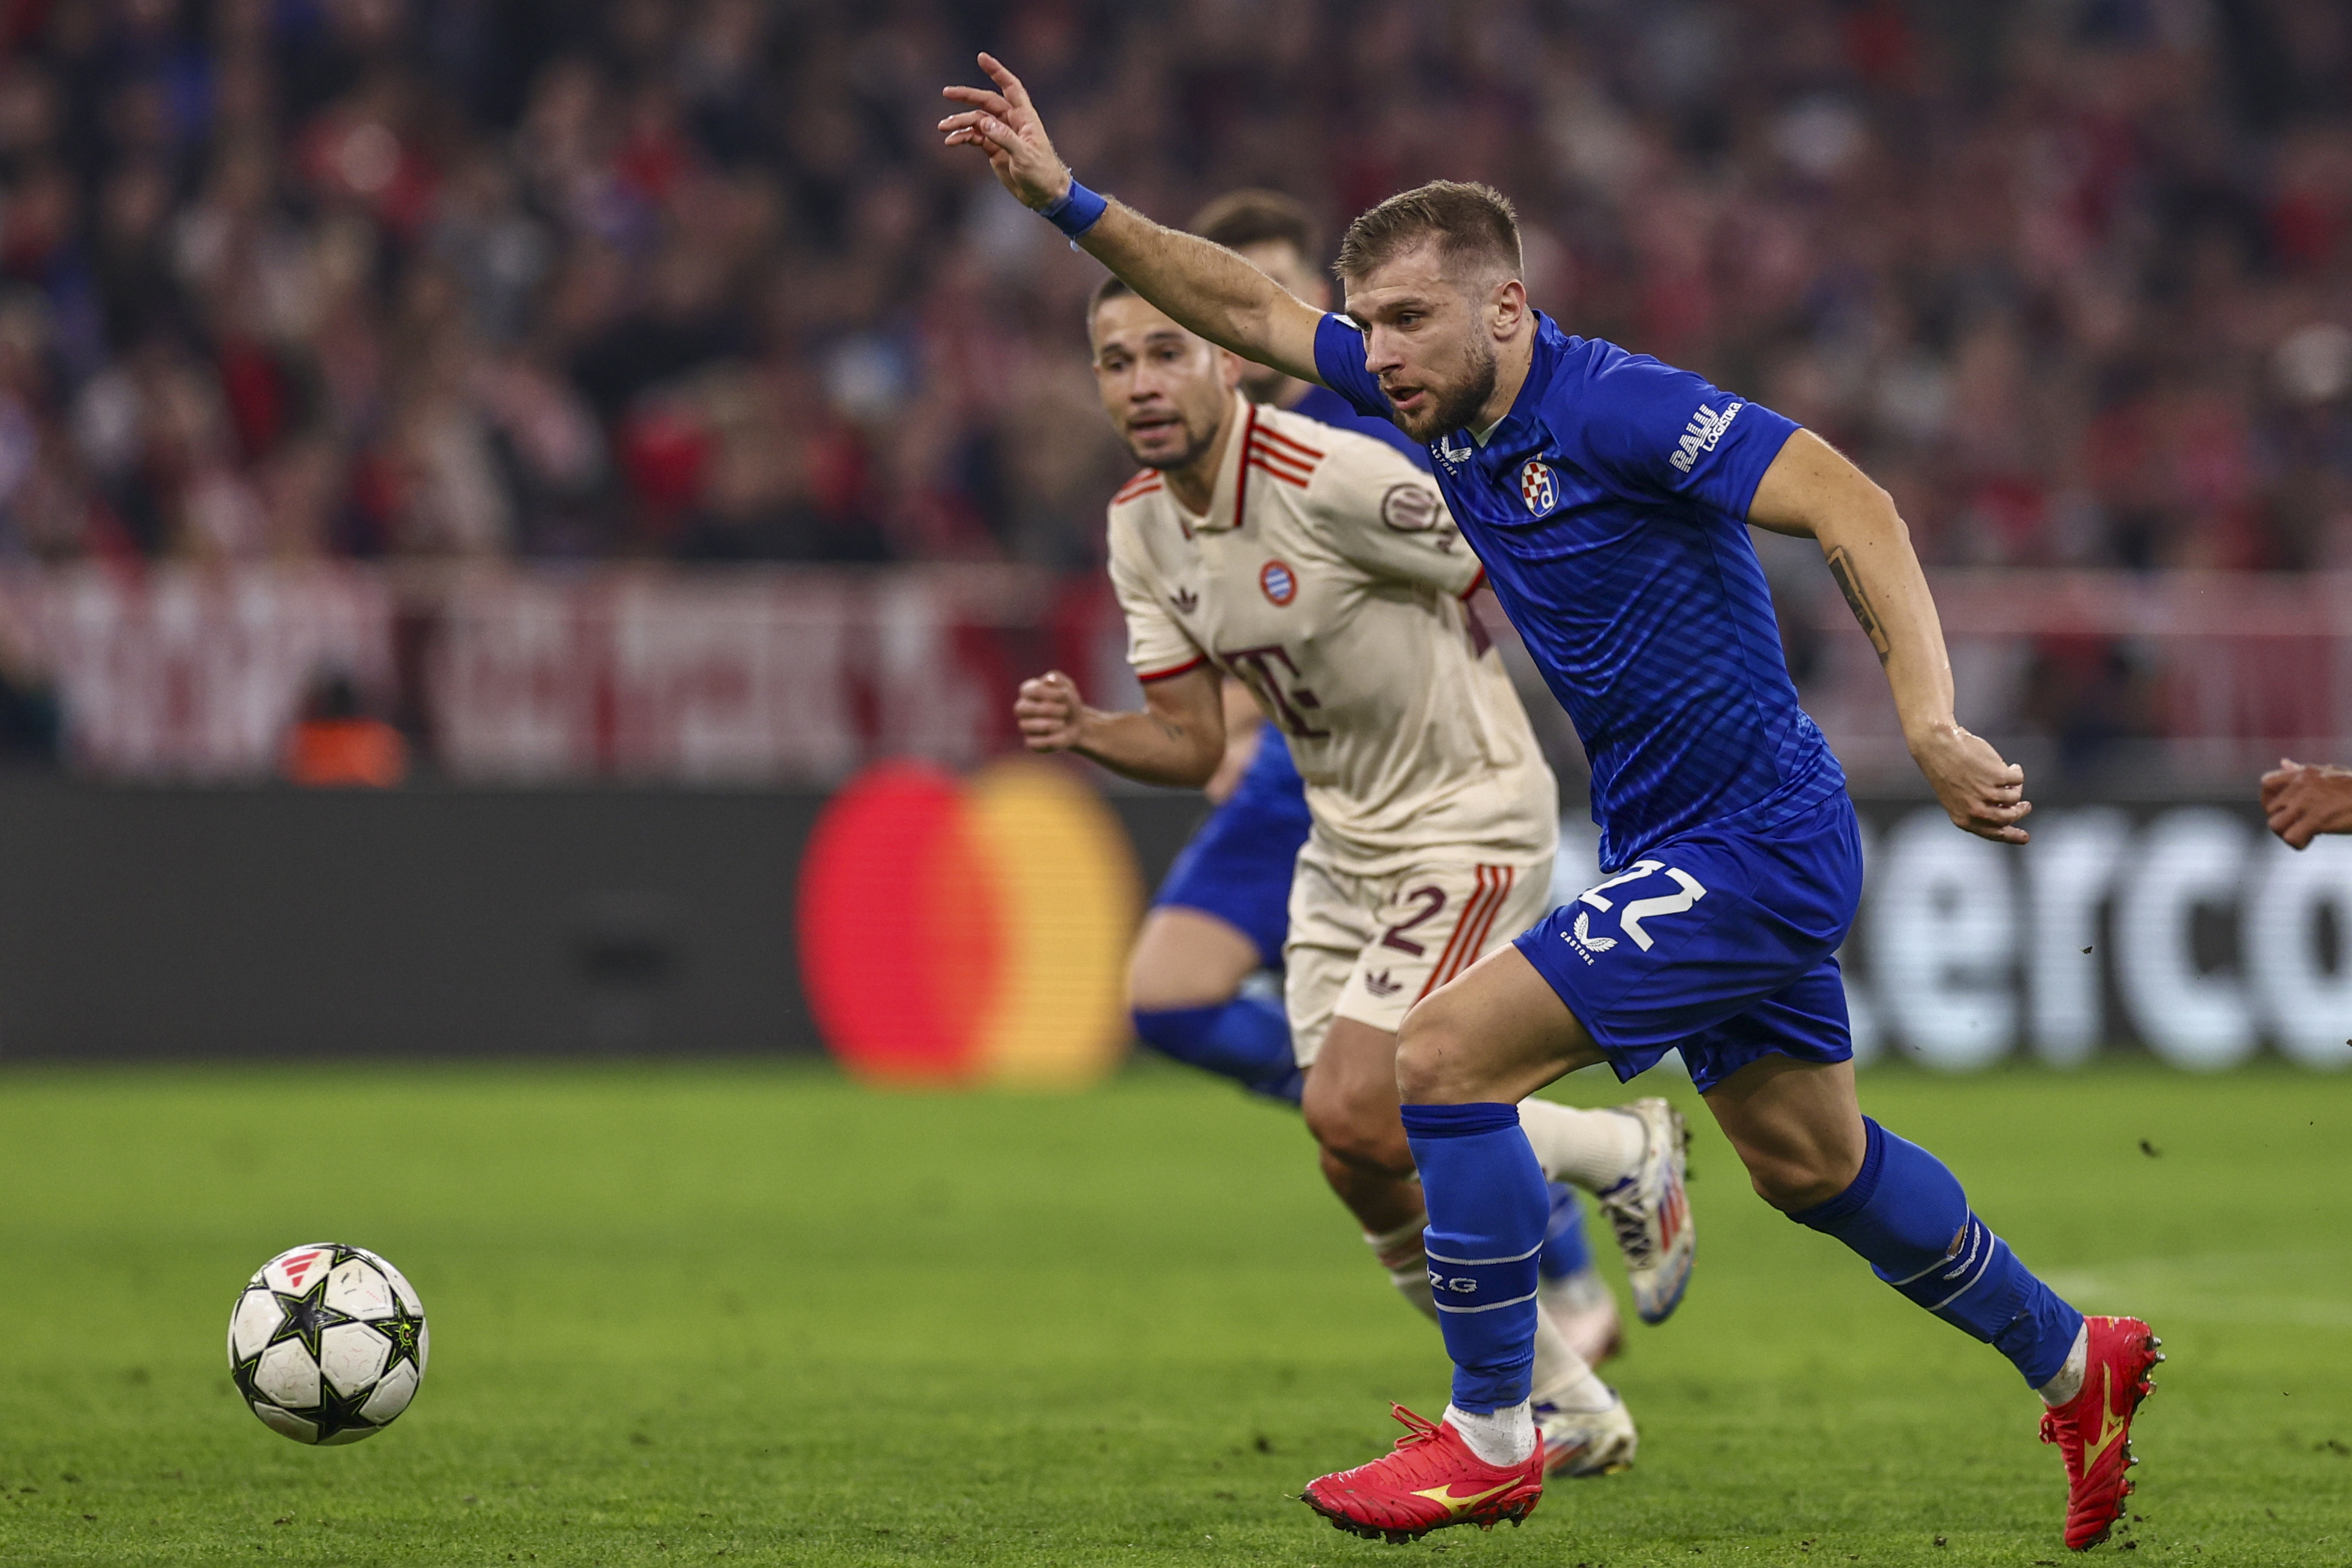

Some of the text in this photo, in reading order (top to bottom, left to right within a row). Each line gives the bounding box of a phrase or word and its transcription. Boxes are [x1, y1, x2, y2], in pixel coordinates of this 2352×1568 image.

[1668, 403, 1720, 474] RALU
[1578, 860, 1708, 953] 22
[1560, 931, 1595, 966] CASTORE
